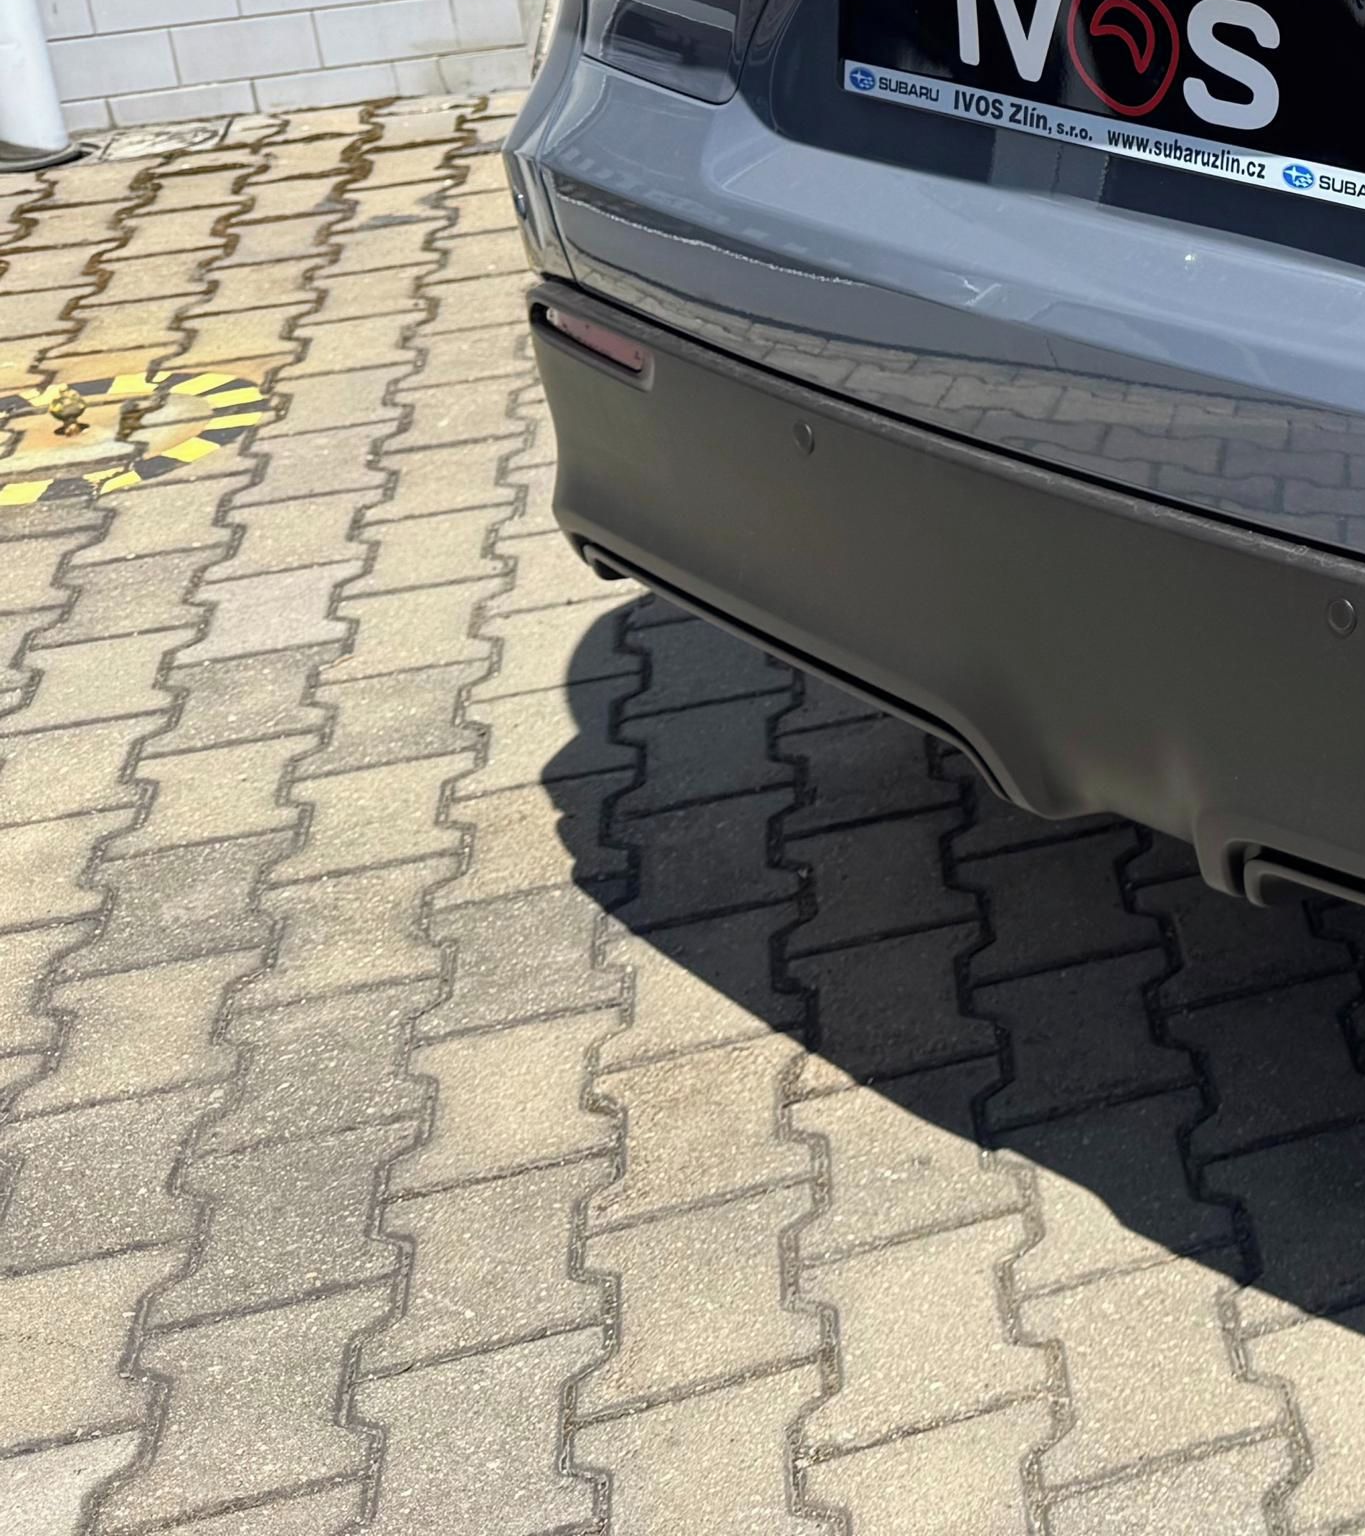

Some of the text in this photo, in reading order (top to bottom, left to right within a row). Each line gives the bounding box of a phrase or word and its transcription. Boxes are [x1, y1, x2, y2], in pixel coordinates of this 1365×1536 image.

[878, 76, 940, 102] SUBARU
[953, 89, 1004, 120] IVOS
[1008, 102, 1053, 135] Zlín,
[1056, 121, 1093, 142] s.r.o.
[1107, 129, 1266, 180] www.subaruzlin.cz
